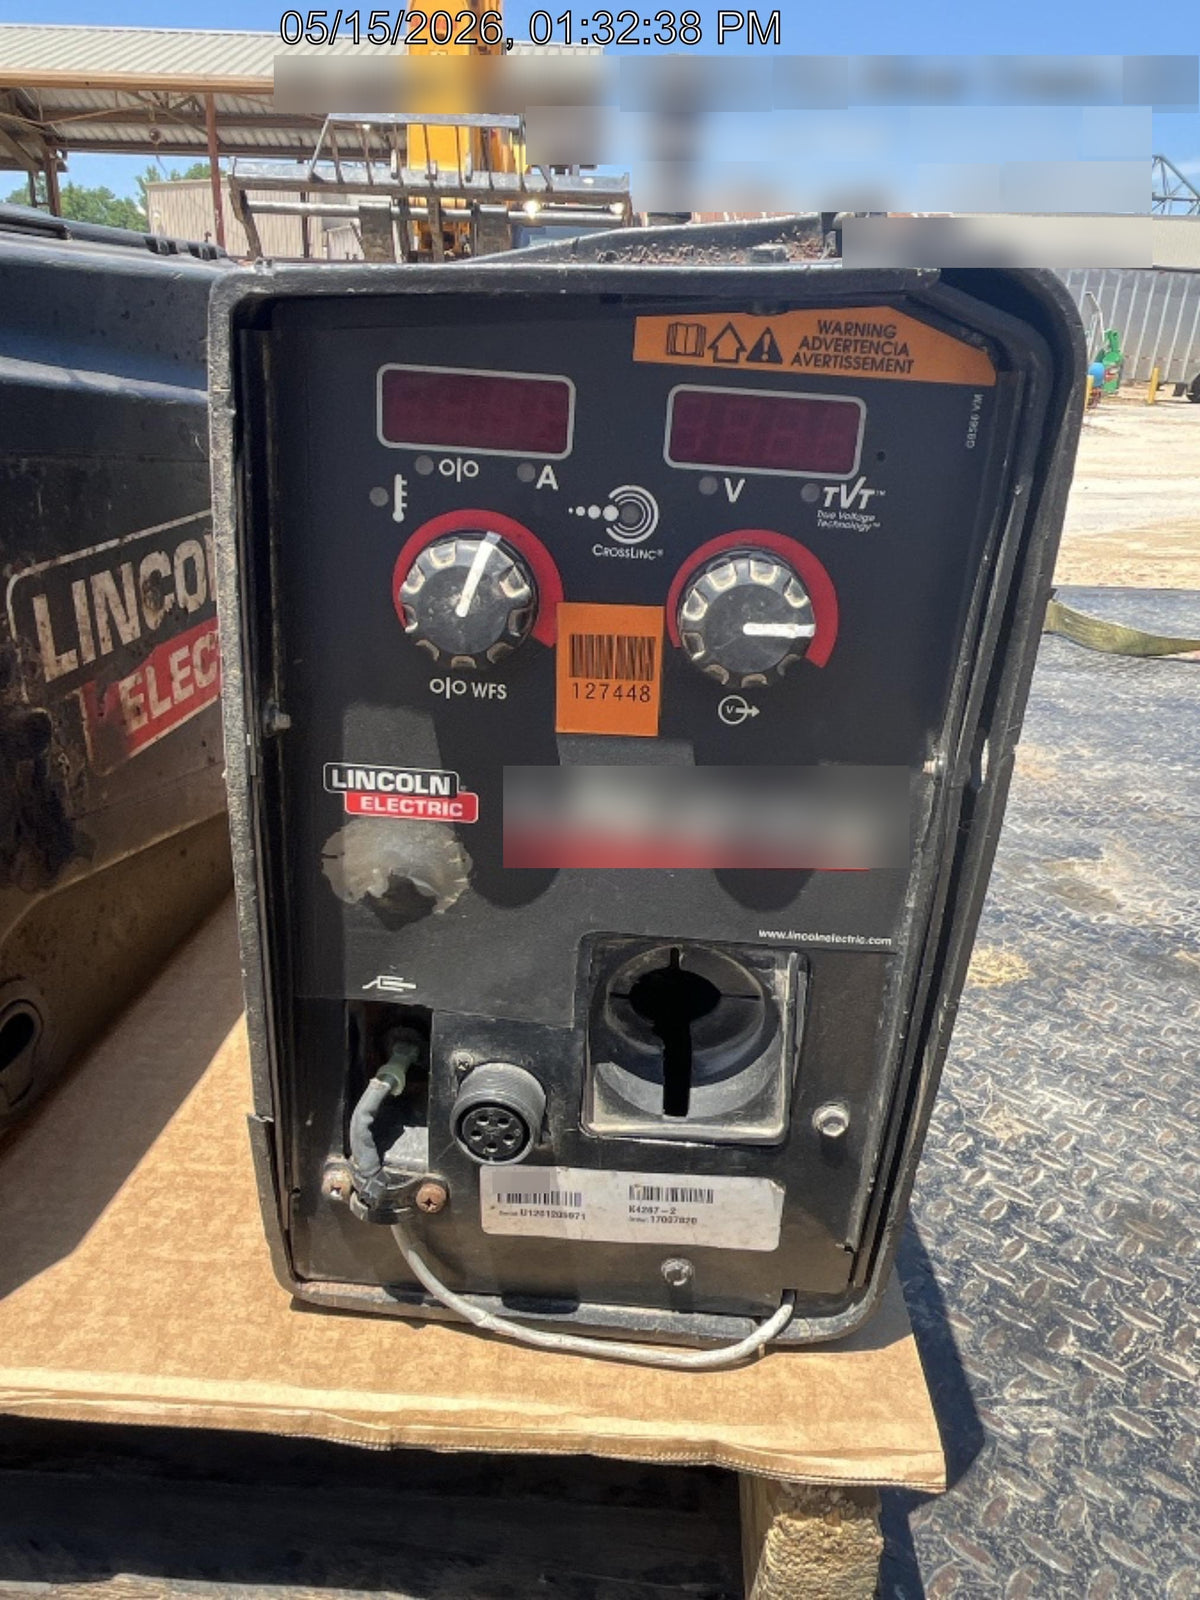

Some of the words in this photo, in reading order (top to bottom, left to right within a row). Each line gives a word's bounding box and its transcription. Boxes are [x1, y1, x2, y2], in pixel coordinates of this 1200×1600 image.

[817, 319, 897, 339] WARNING
[798, 335, 910, 357] ADVERTENCIA
[790, 353, 915, 375] AVERTISSEMENT
[535, 464, 559, 491] A
[724, 477, 746, 503] V
[472, 682, 507, 700] WFS
[573, 682, 651, 703] 127448
[331, 768, 450, 797] LINCOLN
[360, 795, 463, 817] ELECTRIC
[758, 929, 892, 946] www.lincolnelectric.com
